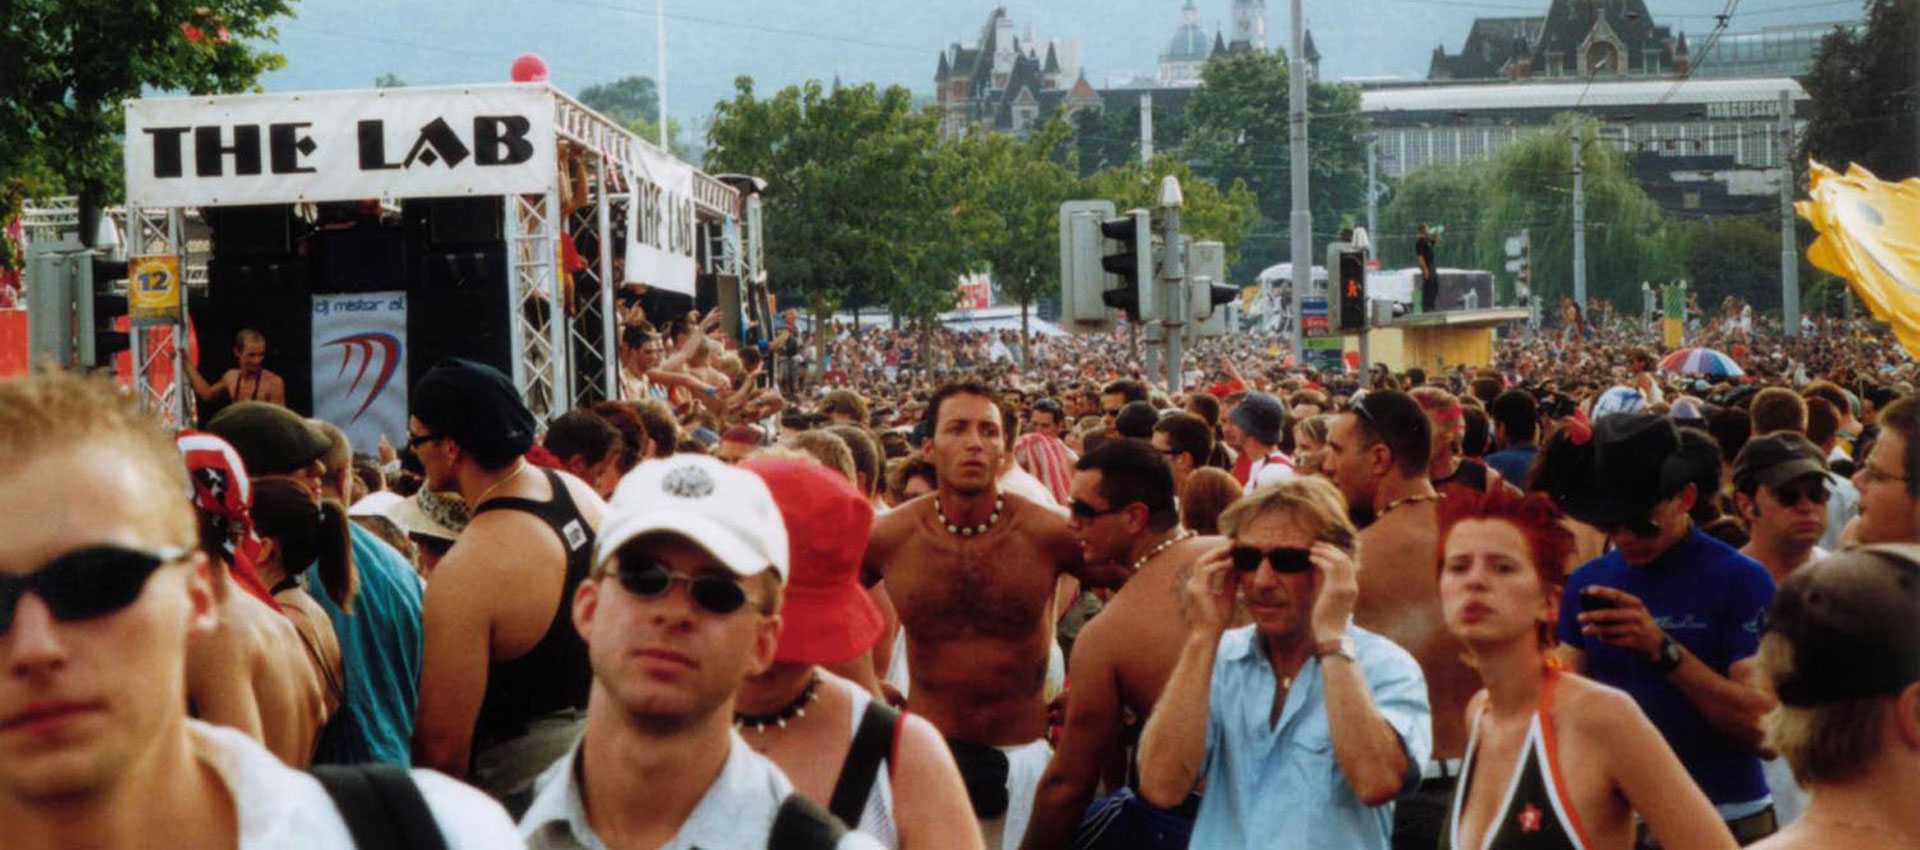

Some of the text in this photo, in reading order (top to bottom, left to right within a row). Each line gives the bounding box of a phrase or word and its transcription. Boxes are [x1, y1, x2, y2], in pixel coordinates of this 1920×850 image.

[143, 116, 534, 178] THE LAB
[636, 177, 662, 249] THE
[137, 271, 168, 291] 12
